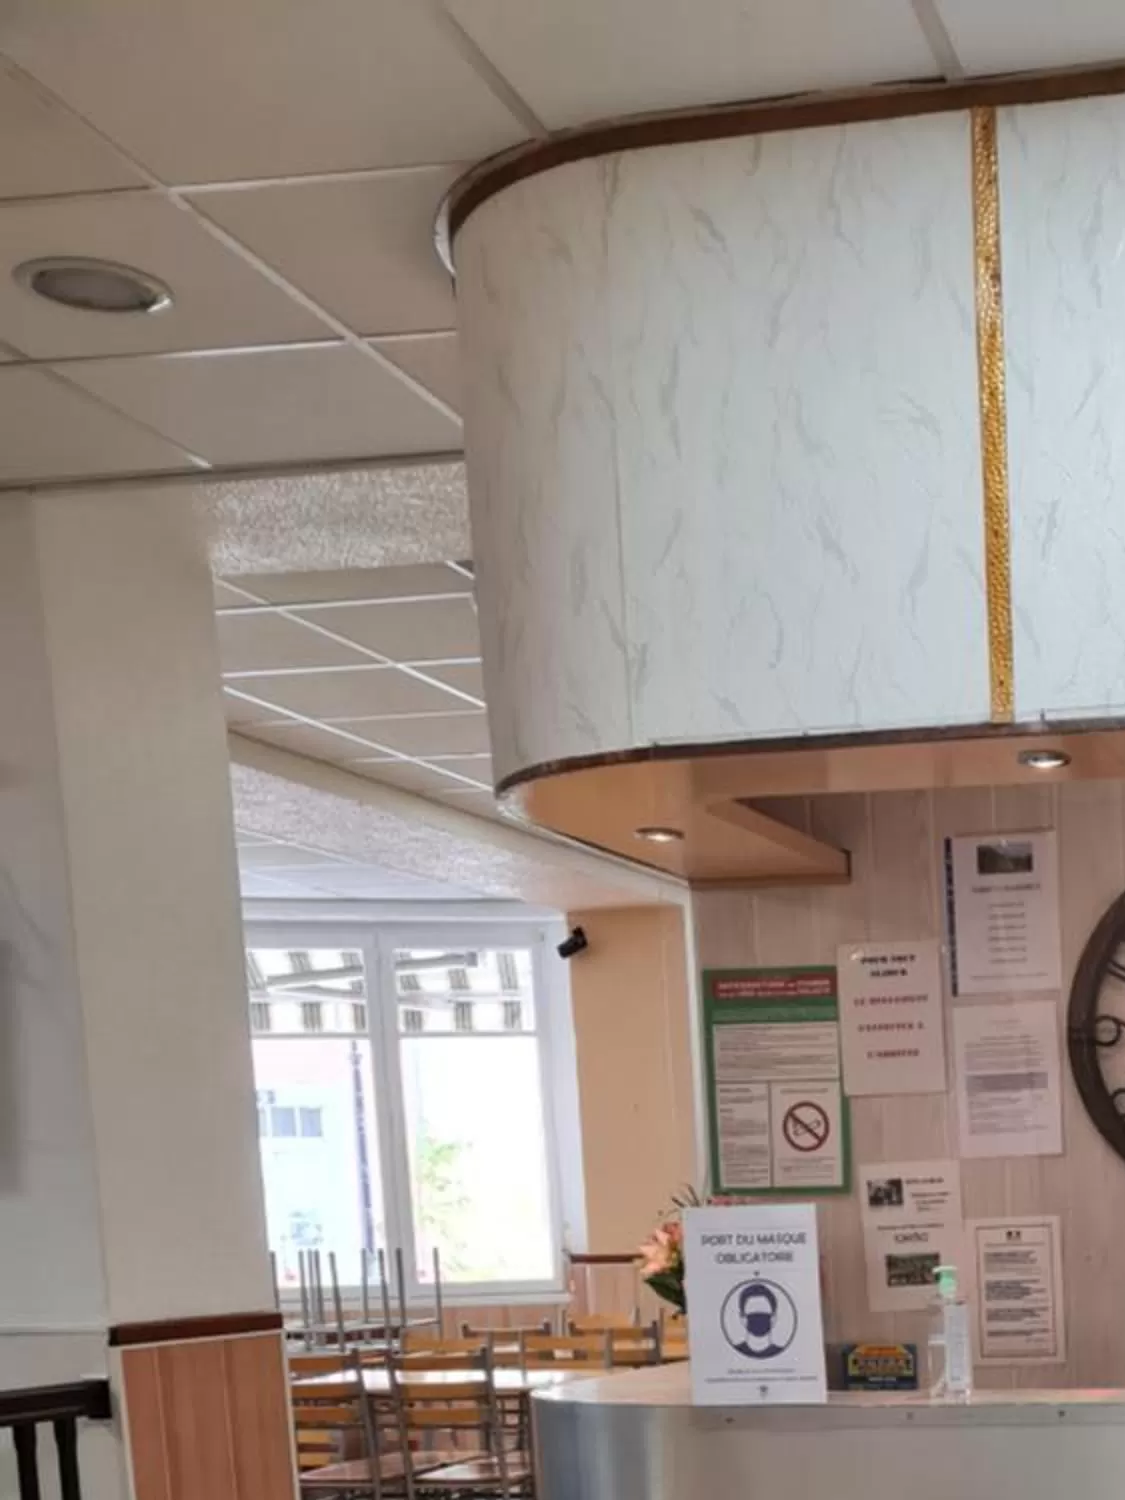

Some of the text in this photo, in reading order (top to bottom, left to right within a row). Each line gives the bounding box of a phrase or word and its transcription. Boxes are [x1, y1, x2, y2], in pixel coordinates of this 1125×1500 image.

[701, 1232, 806, 1247] PORT DU MASQUE
